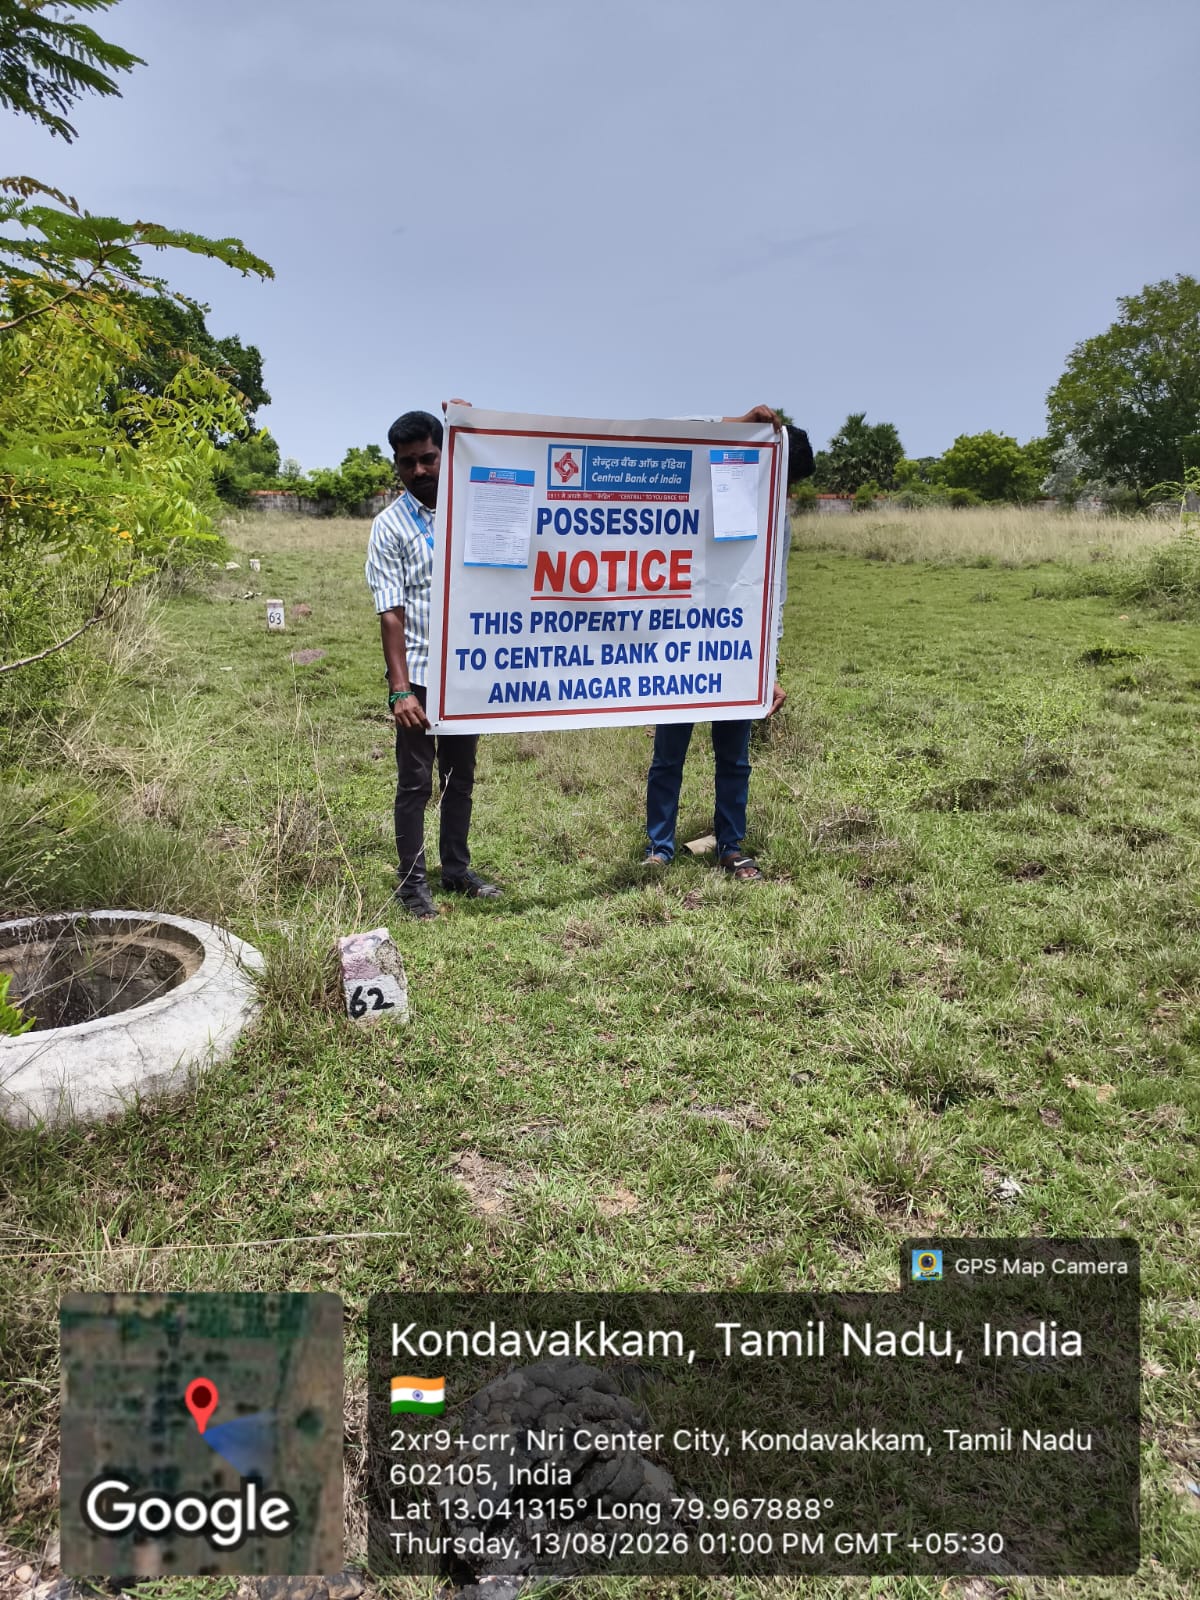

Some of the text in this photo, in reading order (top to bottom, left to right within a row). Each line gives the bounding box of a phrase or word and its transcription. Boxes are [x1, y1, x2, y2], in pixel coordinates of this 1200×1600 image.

[620, 456, 637, 468] बैंक
[661, 458, 686, 470] इंडिया
[591, 472, 682, 485] Central Bank of India
[537, 507, 699, 536] POSSESSION
[534, 550, 692, 594] NOTICE
[269, 612, 282, 625] 63
[470, 607, 743, 635] THIS PROPERTY BELONGS
[456, 640, 753, 671] TO CENTRAL BANK OF INDIA
[488, 672, 722, 704] ANNA NAGAR BRANCH
[350, 986, 395, 1019] 62
